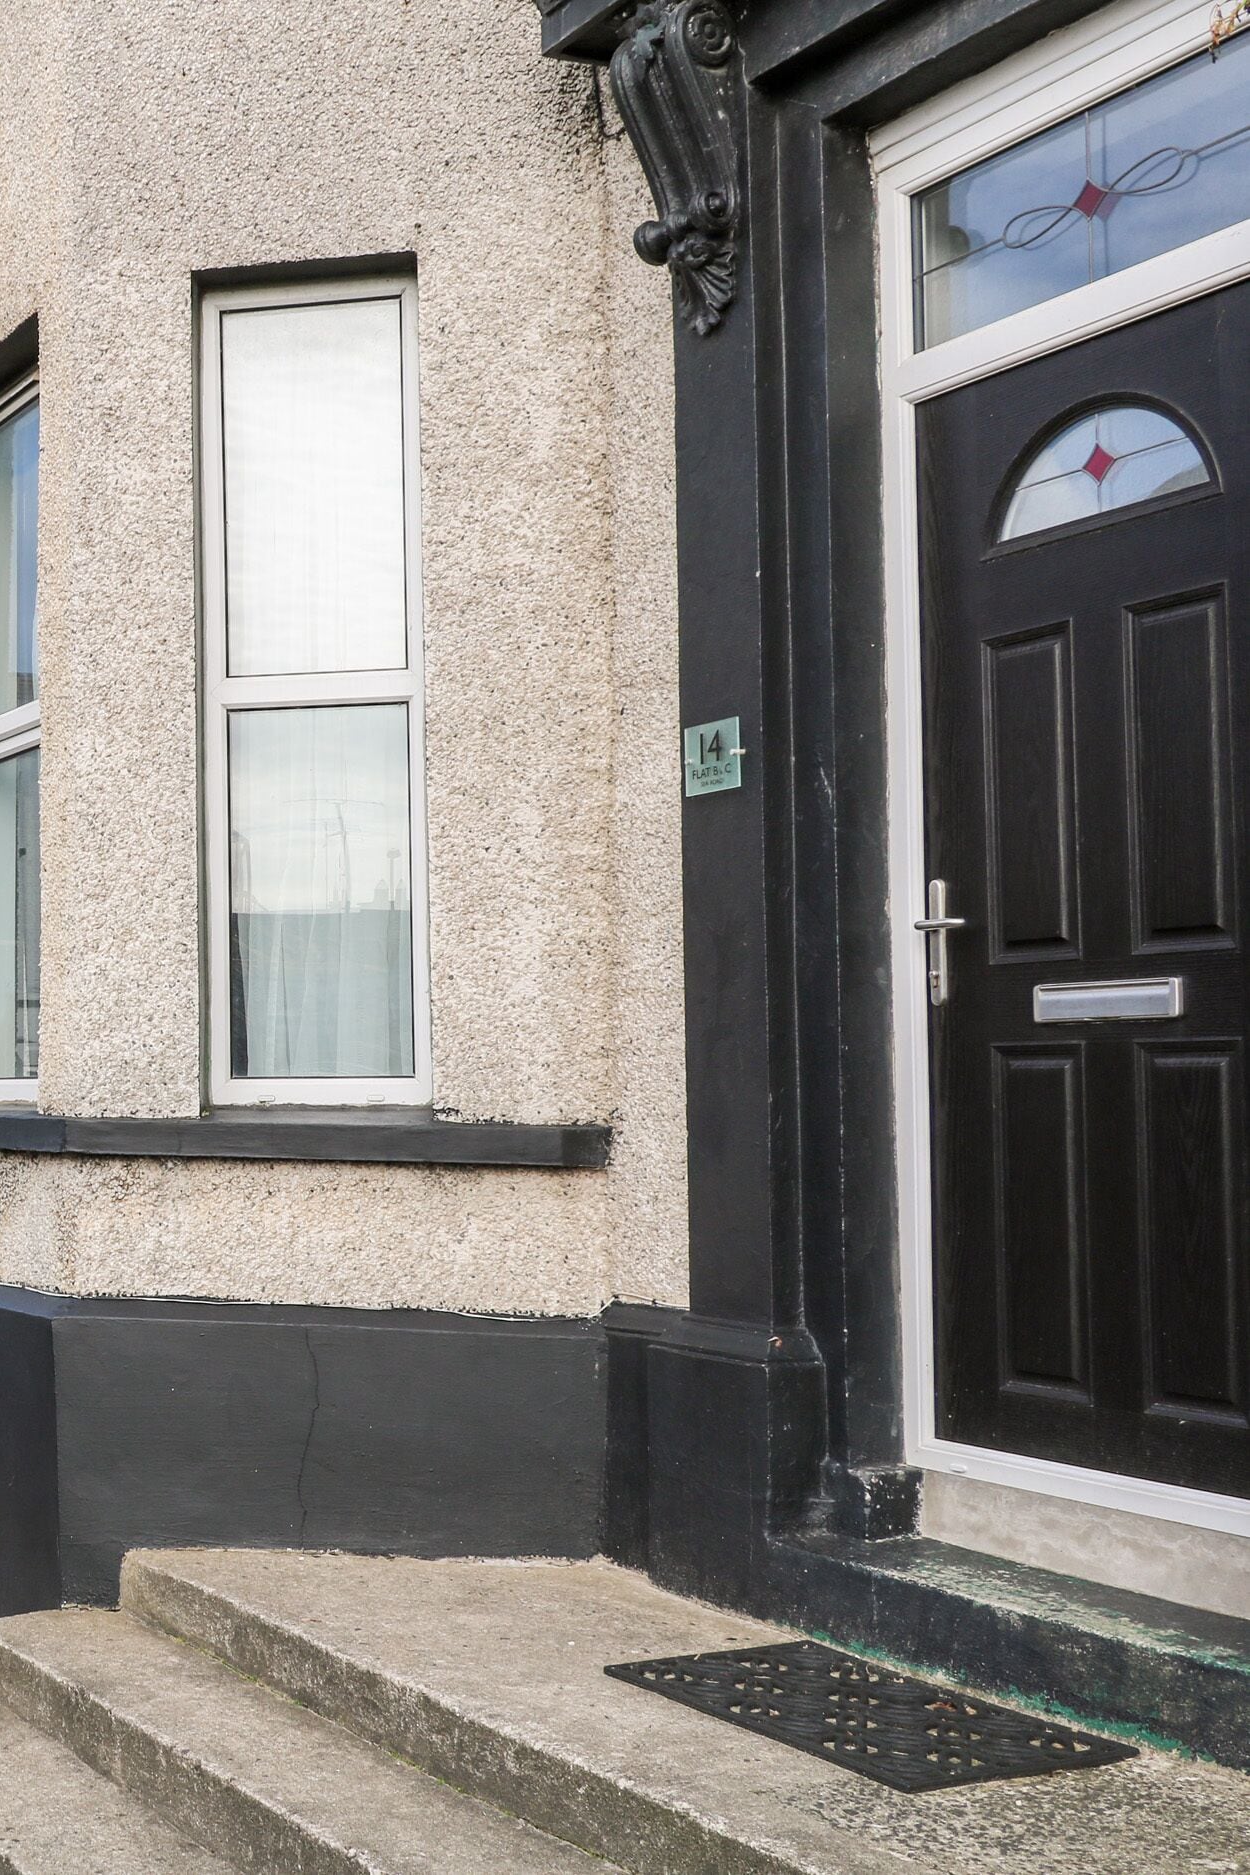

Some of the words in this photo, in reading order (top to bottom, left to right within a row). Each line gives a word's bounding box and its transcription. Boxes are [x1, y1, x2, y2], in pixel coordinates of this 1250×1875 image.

[699, 729, 722, 764] 14
[692, 766, 711, 780] FLAT
[712, 766, 719, 776] B
[724, 762, 732, 774] C
